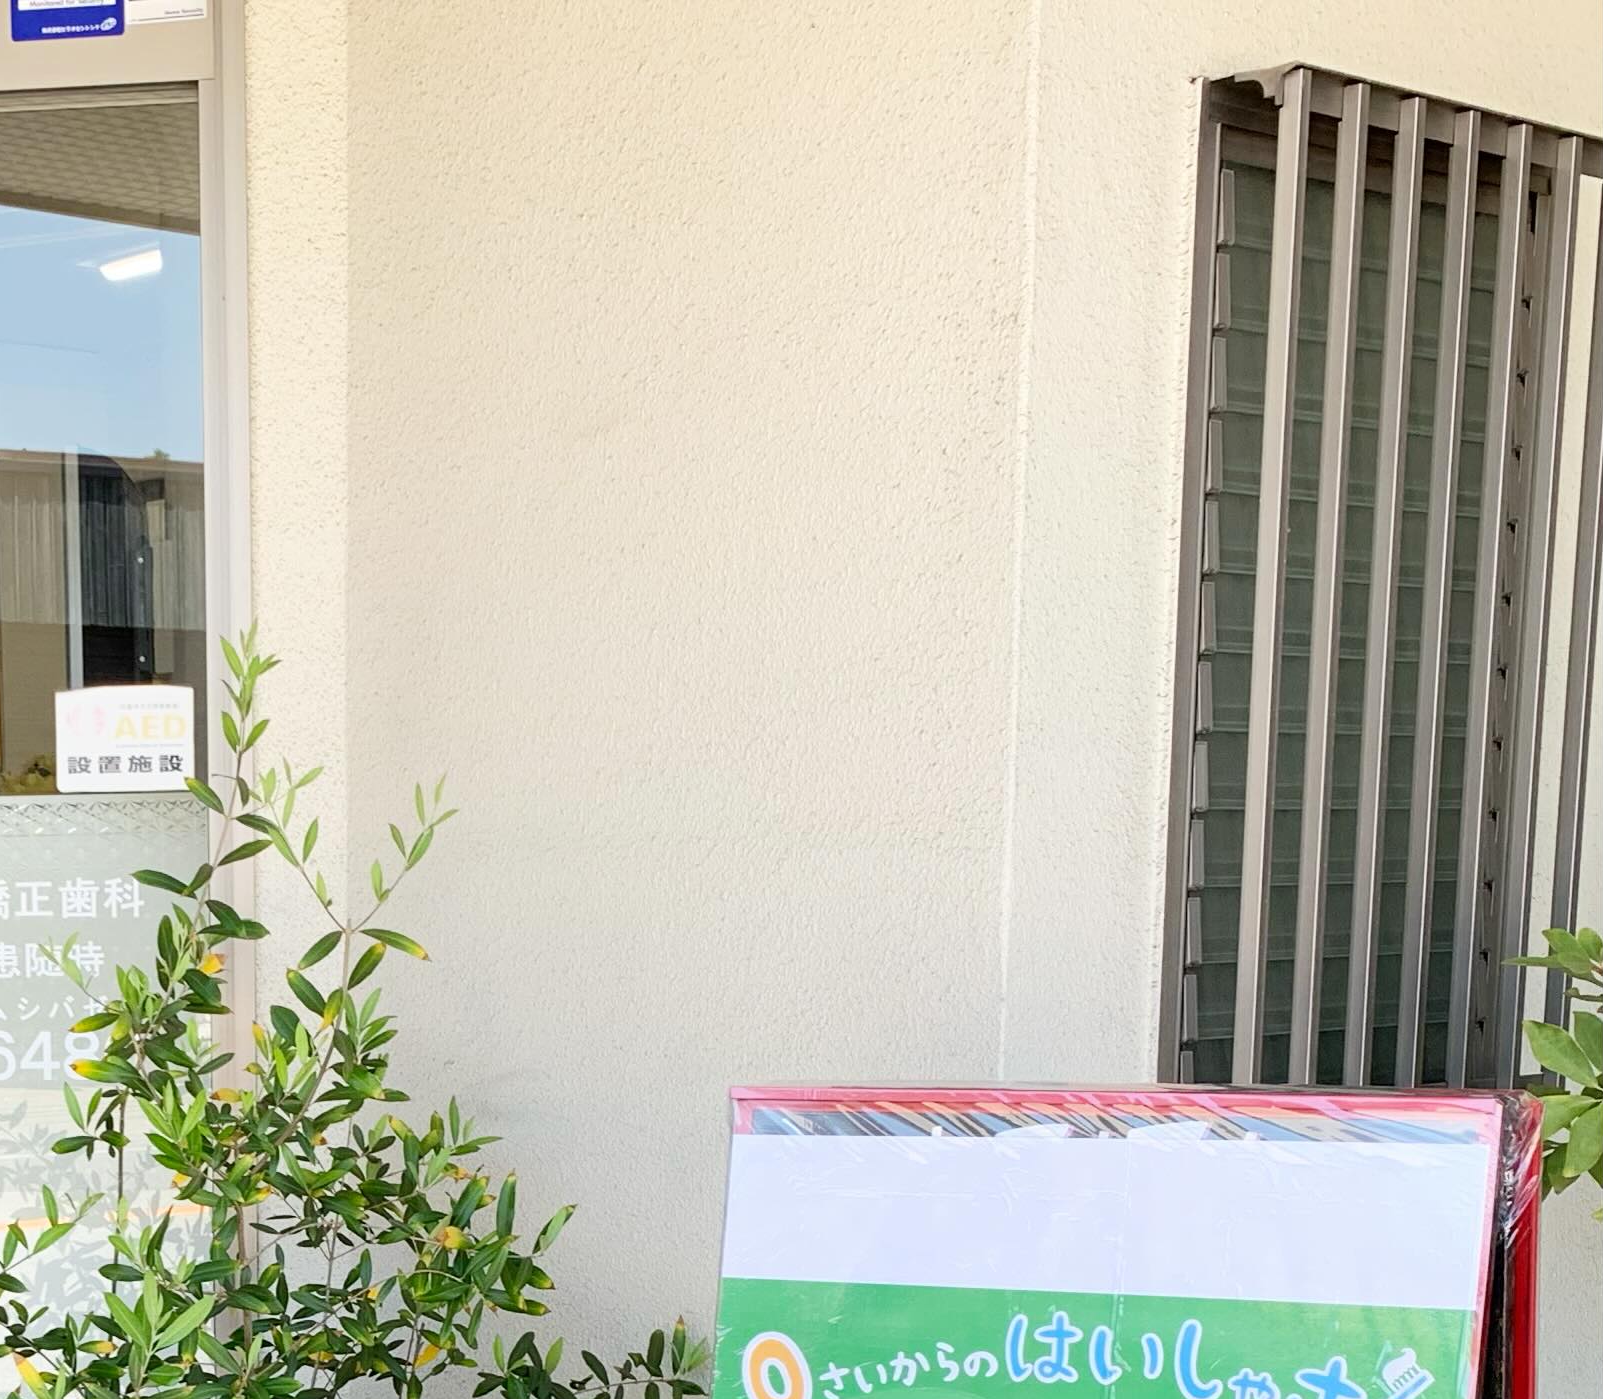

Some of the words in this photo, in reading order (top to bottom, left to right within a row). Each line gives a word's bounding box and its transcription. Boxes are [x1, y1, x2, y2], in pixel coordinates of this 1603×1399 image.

[115, 714, 186, 738] AED
[67, 755, 183, 774] 設置施設
